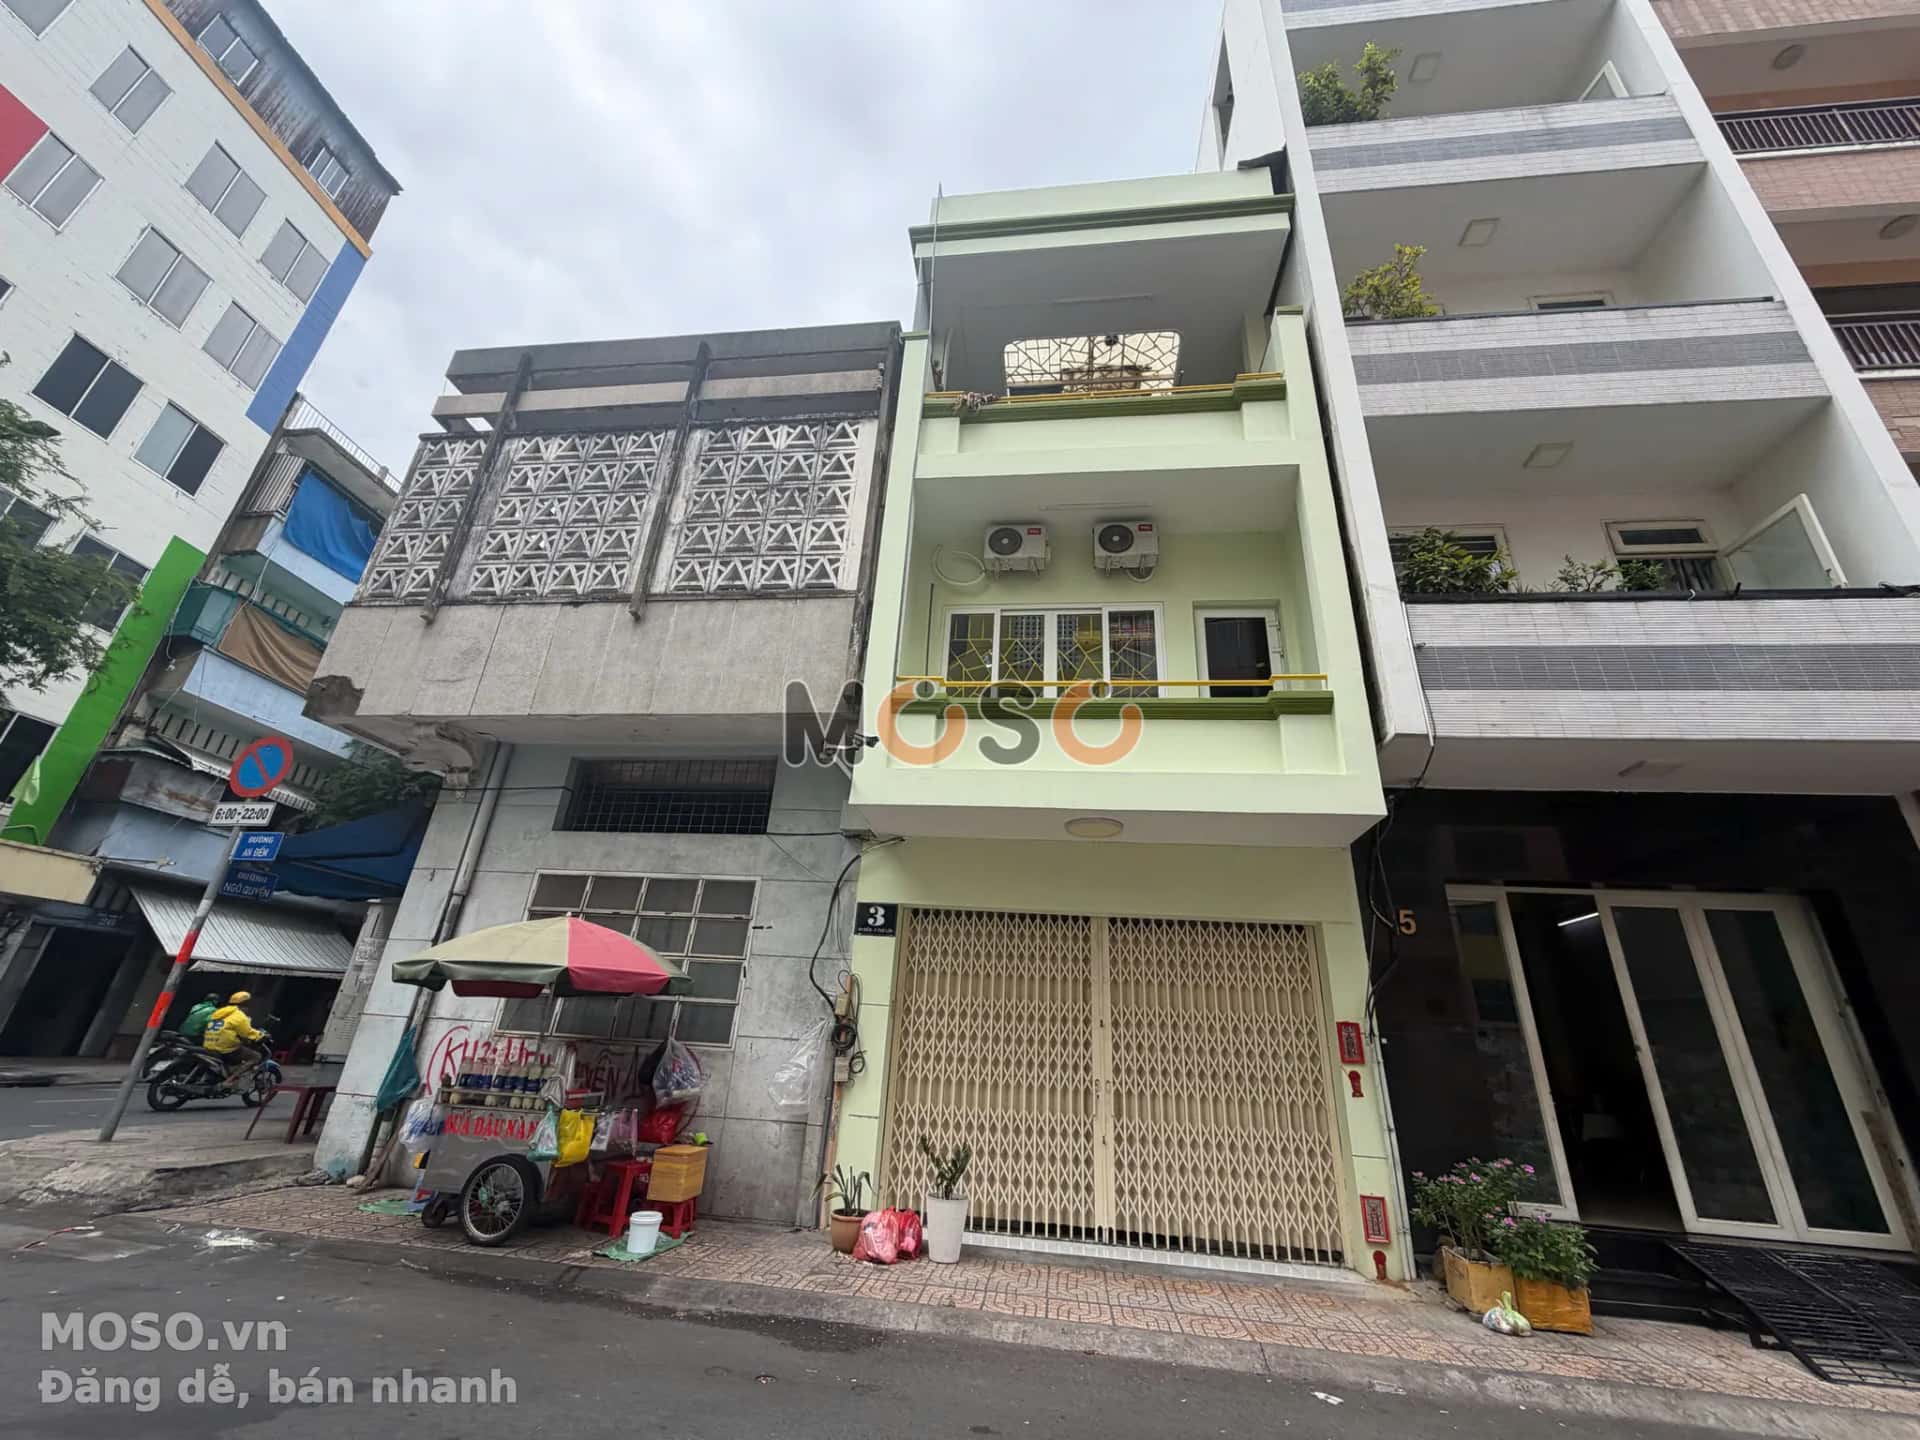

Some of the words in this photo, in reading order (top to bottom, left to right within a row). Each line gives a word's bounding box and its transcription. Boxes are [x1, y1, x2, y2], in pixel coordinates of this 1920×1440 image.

[867, 905, 885, 926] 3
[1399, 909, 1417, 935] 5
[505, 1115, 541, 1141] NÀN
